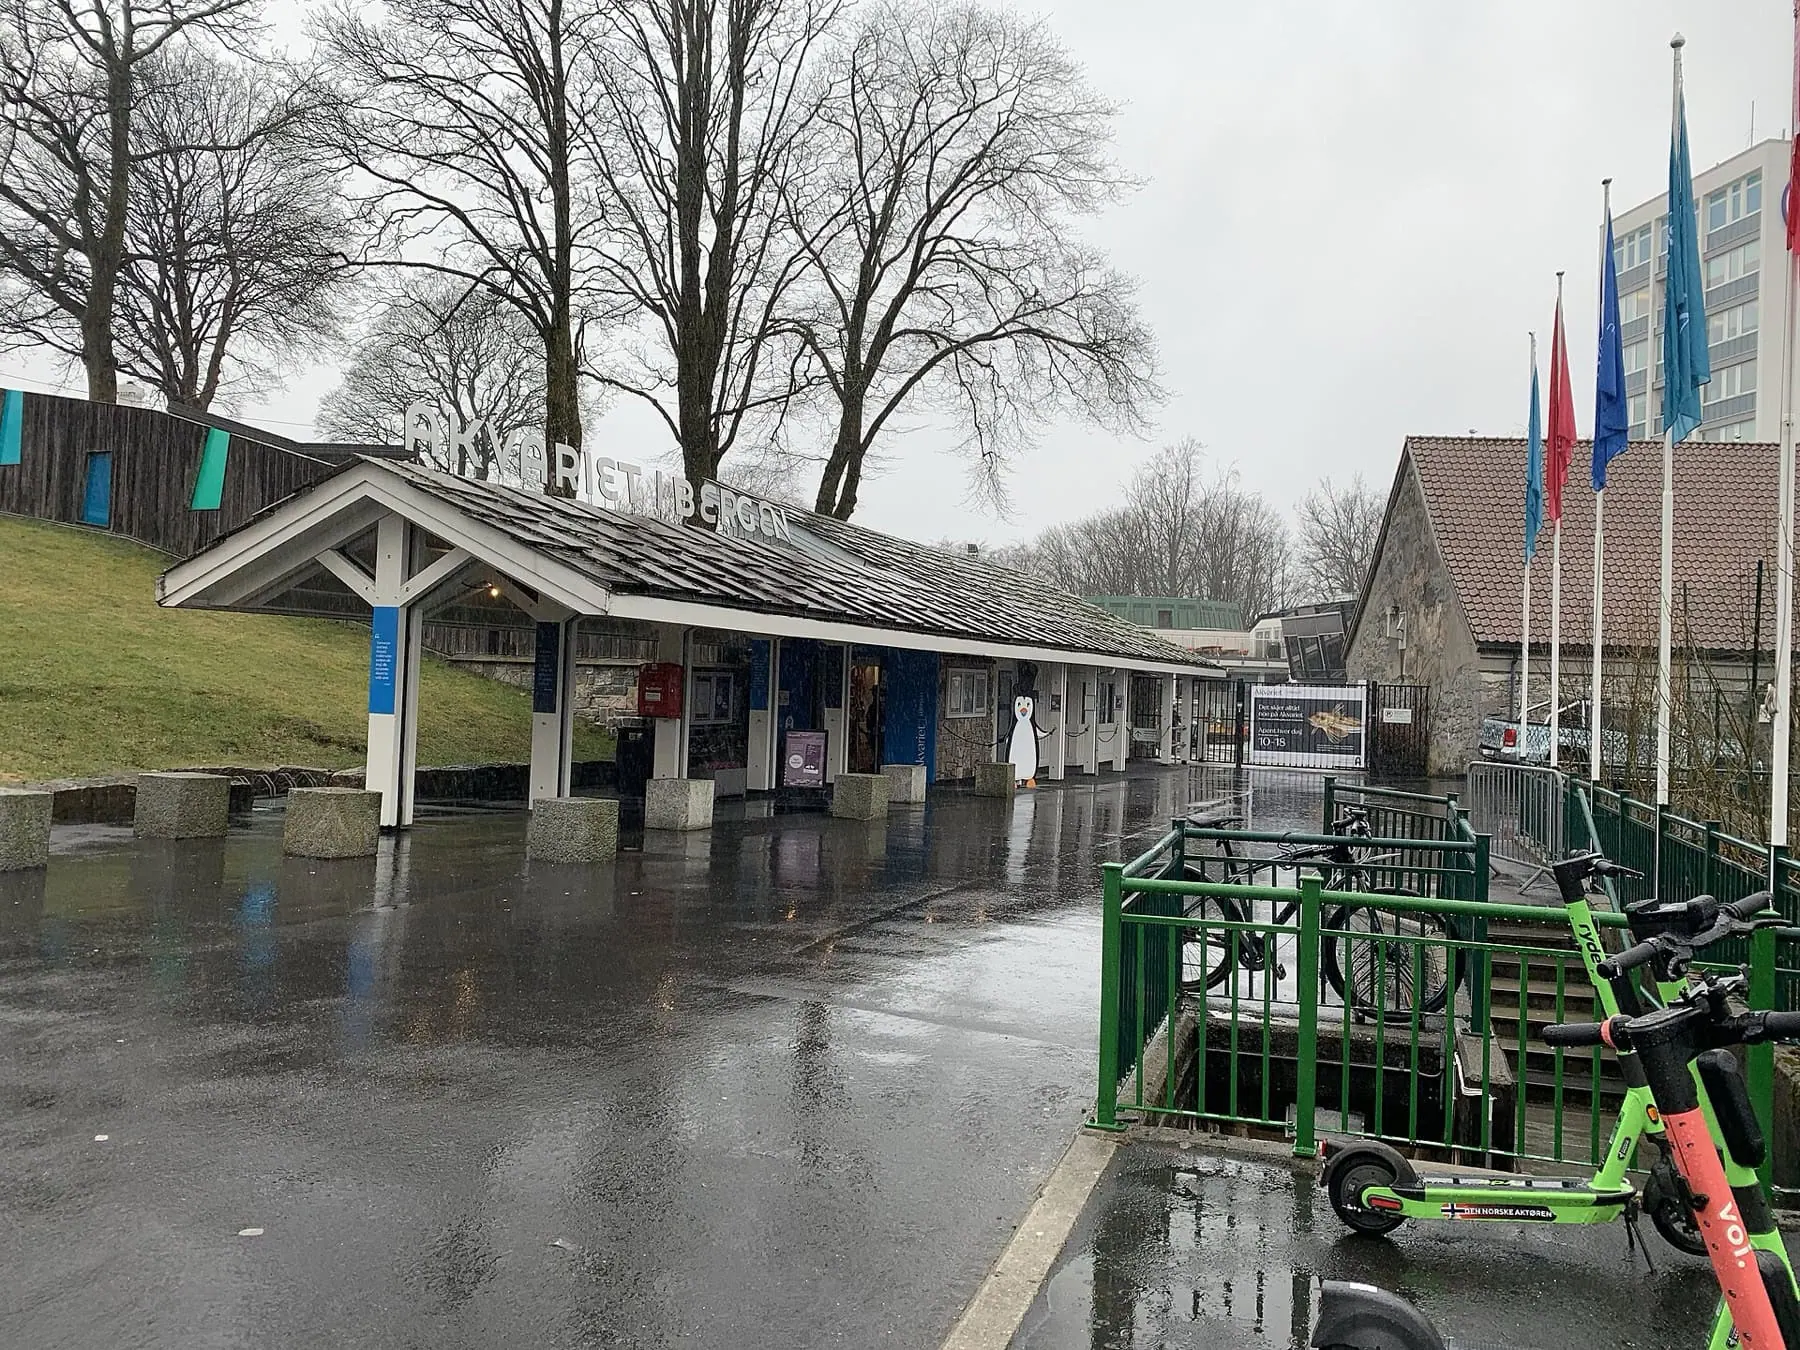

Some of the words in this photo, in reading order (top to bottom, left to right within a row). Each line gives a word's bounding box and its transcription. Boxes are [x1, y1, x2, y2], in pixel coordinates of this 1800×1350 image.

[404, 402, 641, 504] AKVARIET
[655, 470, 664, 510] I
[672, 476, 793, 544] BERGEN
[1258, 703, 1270, 711] Det
[1258, 737, 1286, 747] 10-18
[1578, 923, 1602, 964] ryde
[1464, 1207, 1481, 1215] DEN
[1481, 1208, 1514, 1216] NORSKE
[1515, 1208, 1552, 1218] AKTØREN
